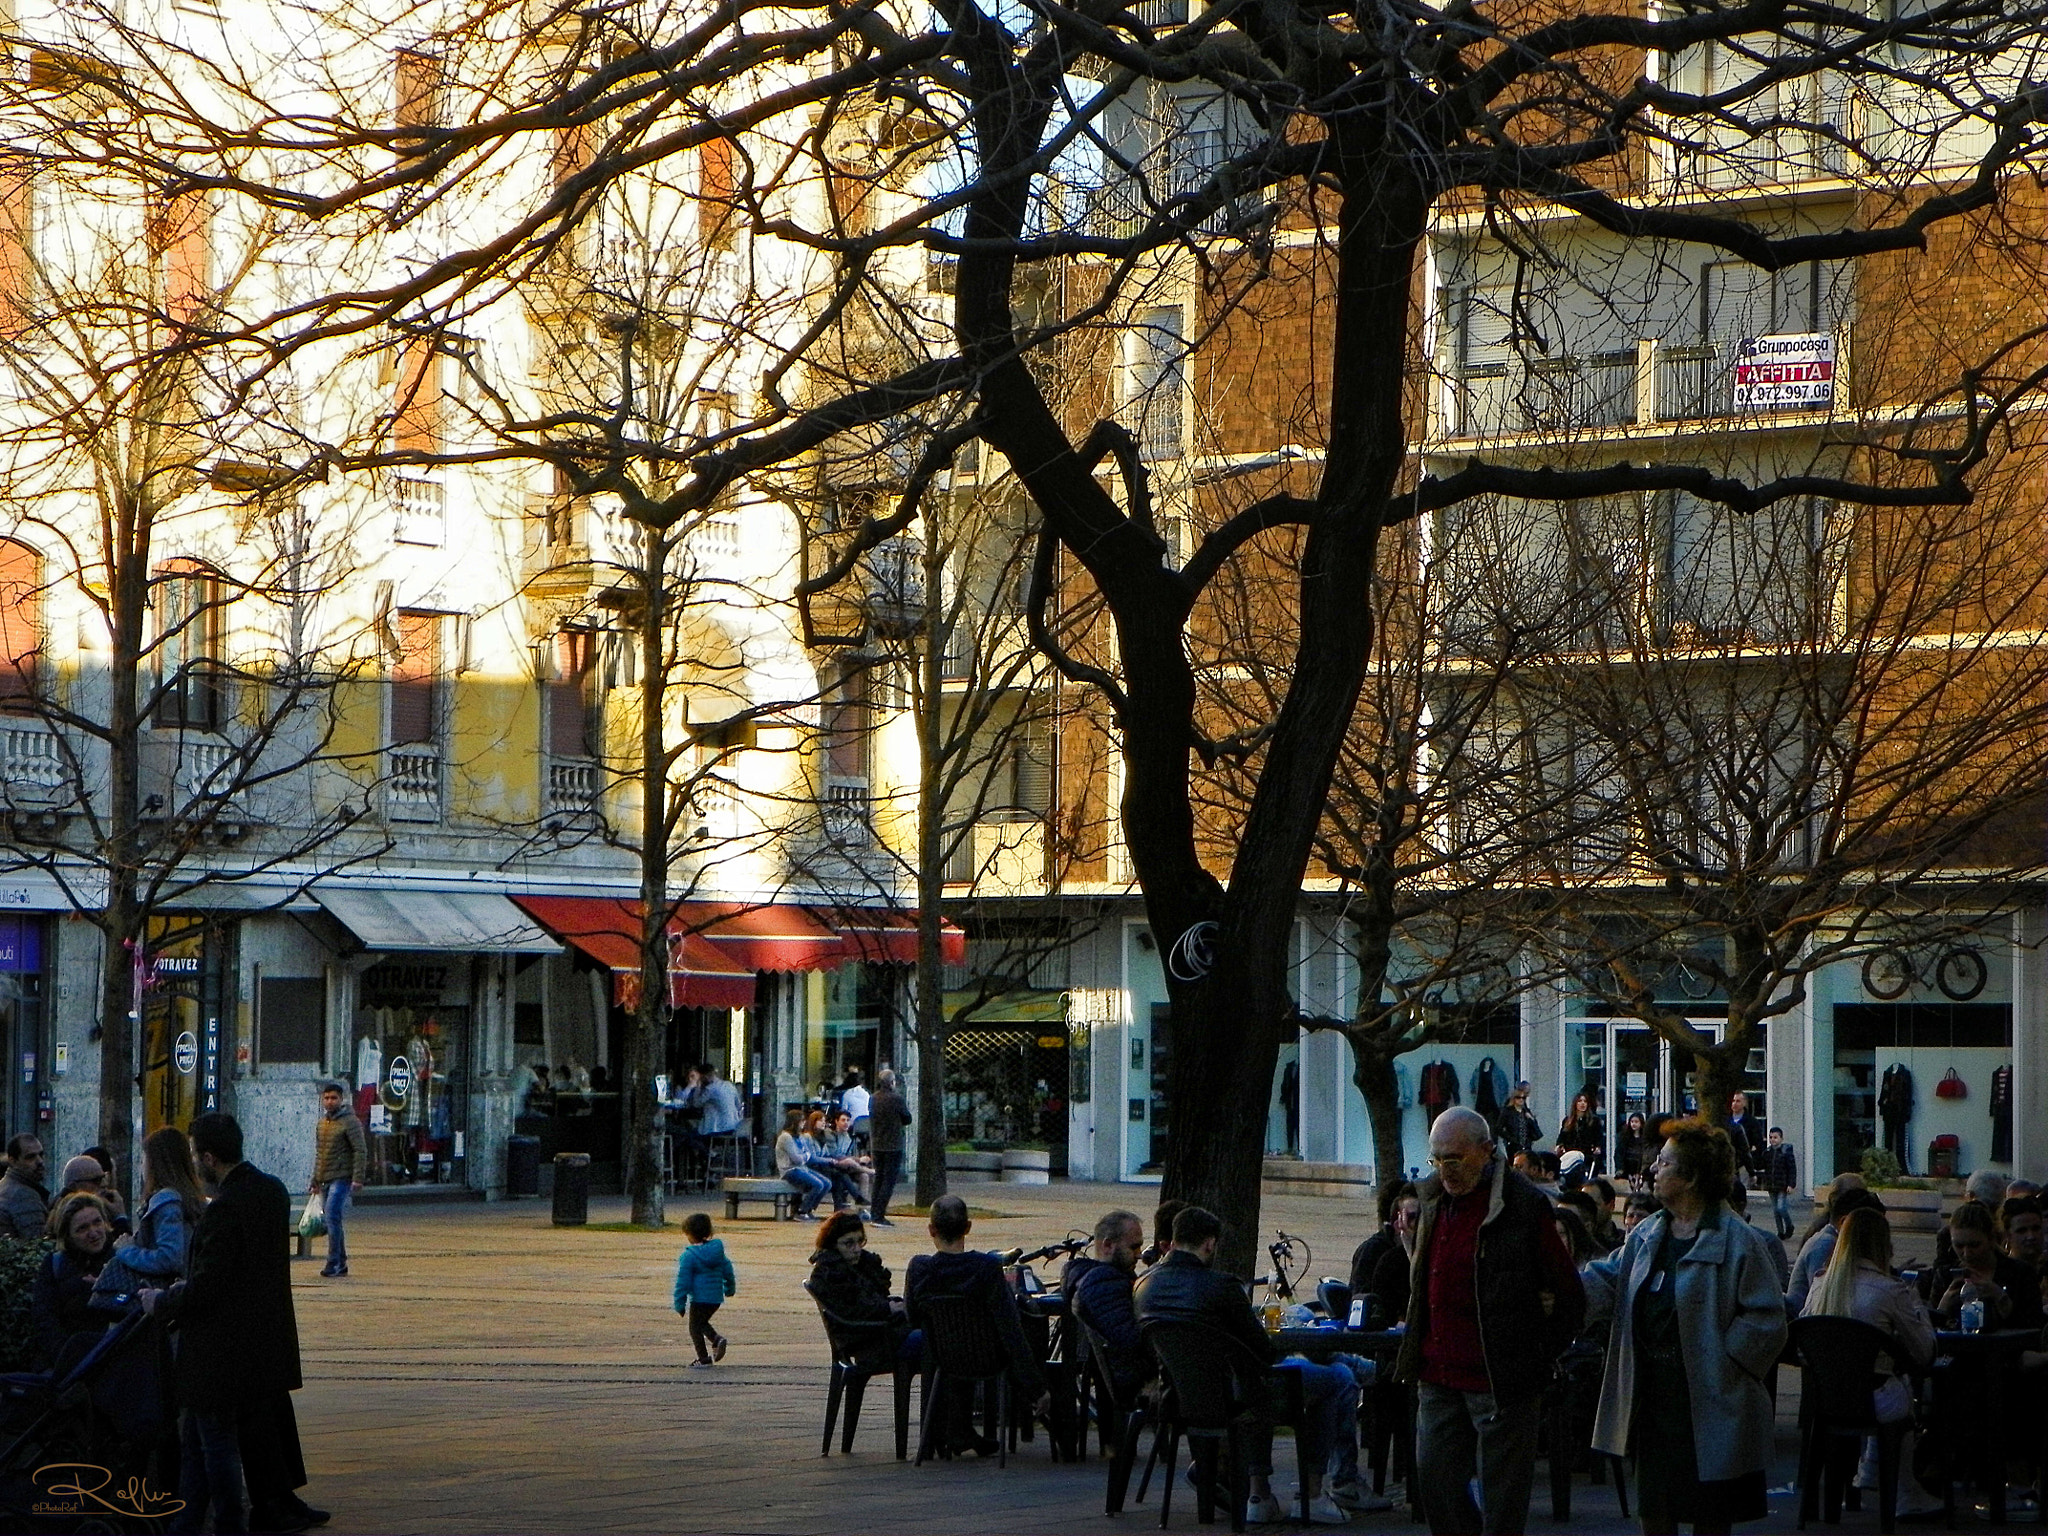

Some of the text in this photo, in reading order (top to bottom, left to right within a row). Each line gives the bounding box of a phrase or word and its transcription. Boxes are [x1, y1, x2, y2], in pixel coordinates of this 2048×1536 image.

[1758, 339, 1829, 355] Gruppocasa
[1746, 362, 1823, 382] AFFITTA
[160, 958, 198, 971] OTRAVEZ
[367, 965, 447, 989] OTRAVEZ
[206, 1017, 217, 1108] ENTRA
